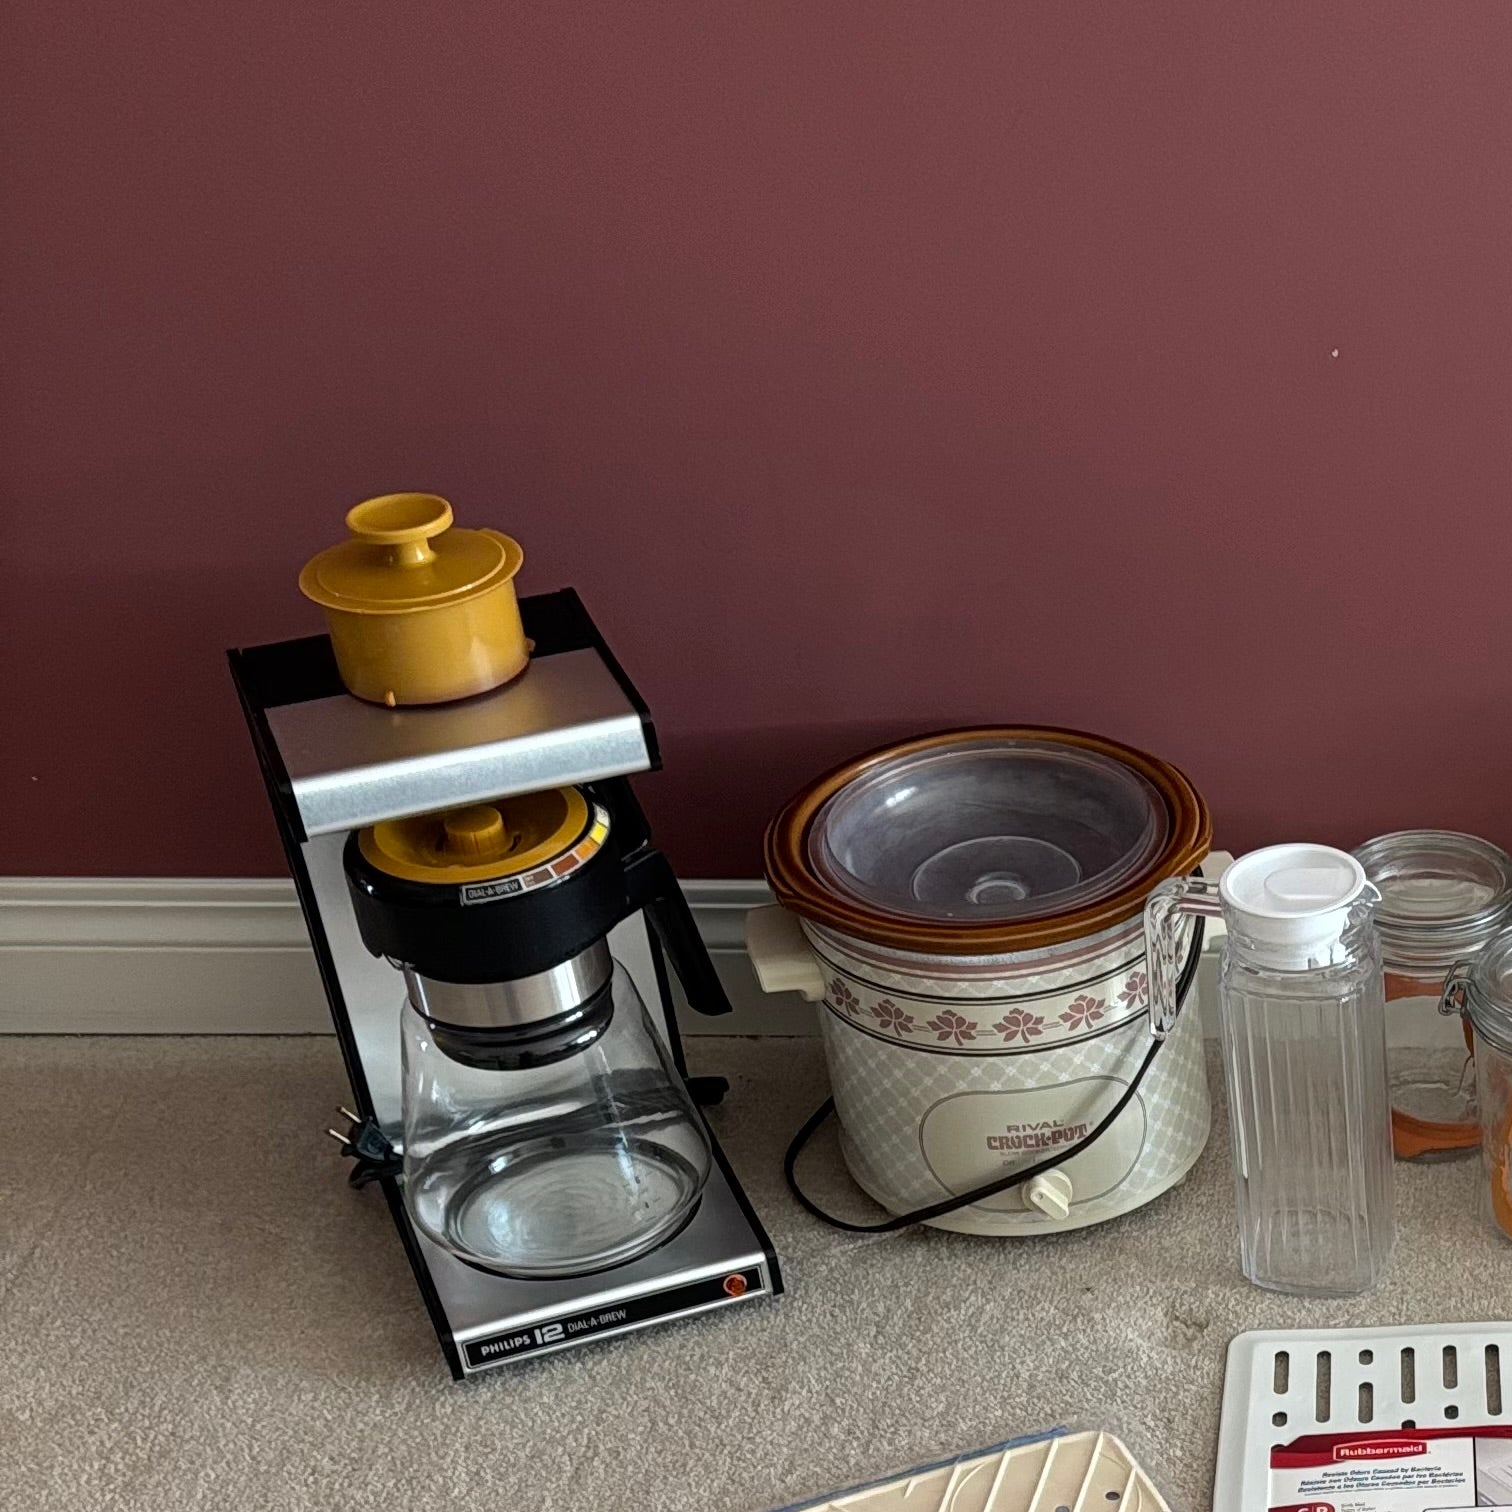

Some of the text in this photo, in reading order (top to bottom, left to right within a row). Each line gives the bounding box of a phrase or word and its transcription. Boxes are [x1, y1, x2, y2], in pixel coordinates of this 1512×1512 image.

[1006, 1119, 1064, 1133] RIVAL
[481, 1334, 531, 1356] PHILIPS
[534, 1323, 565, 1345] 12
[1340, 1444, 1423, 1457] Rubbermaid
